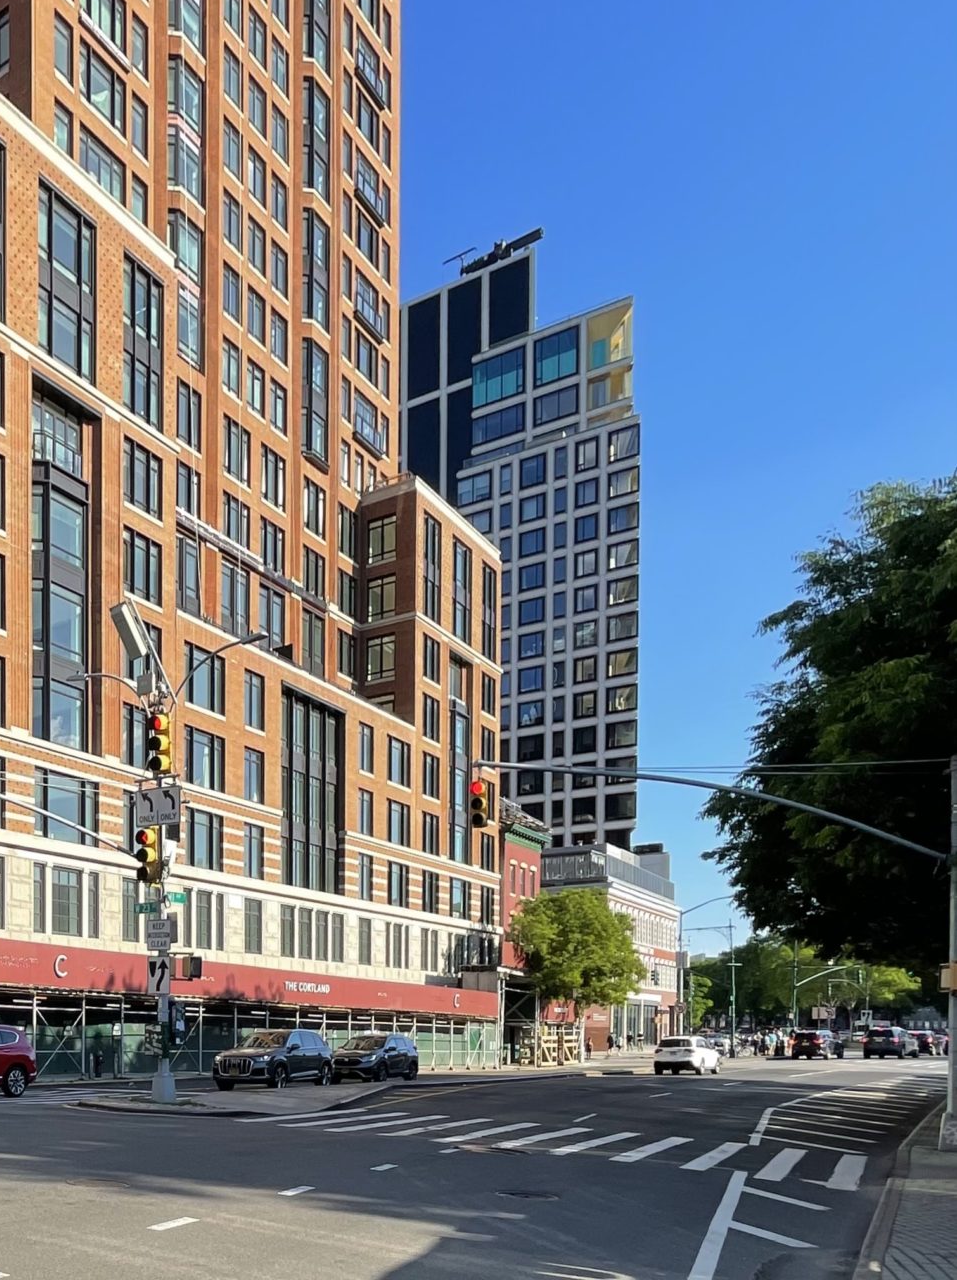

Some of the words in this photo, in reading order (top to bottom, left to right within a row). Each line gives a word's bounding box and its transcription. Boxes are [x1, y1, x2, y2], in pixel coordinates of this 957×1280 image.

[139, 815, 155, 823] ONLY
[160, 812, 177, 821] ONLY
[55, 954, 68, 978] C
[284, 981, 297, 991] THE
[298, 982, 331, 993] CORTLAND
